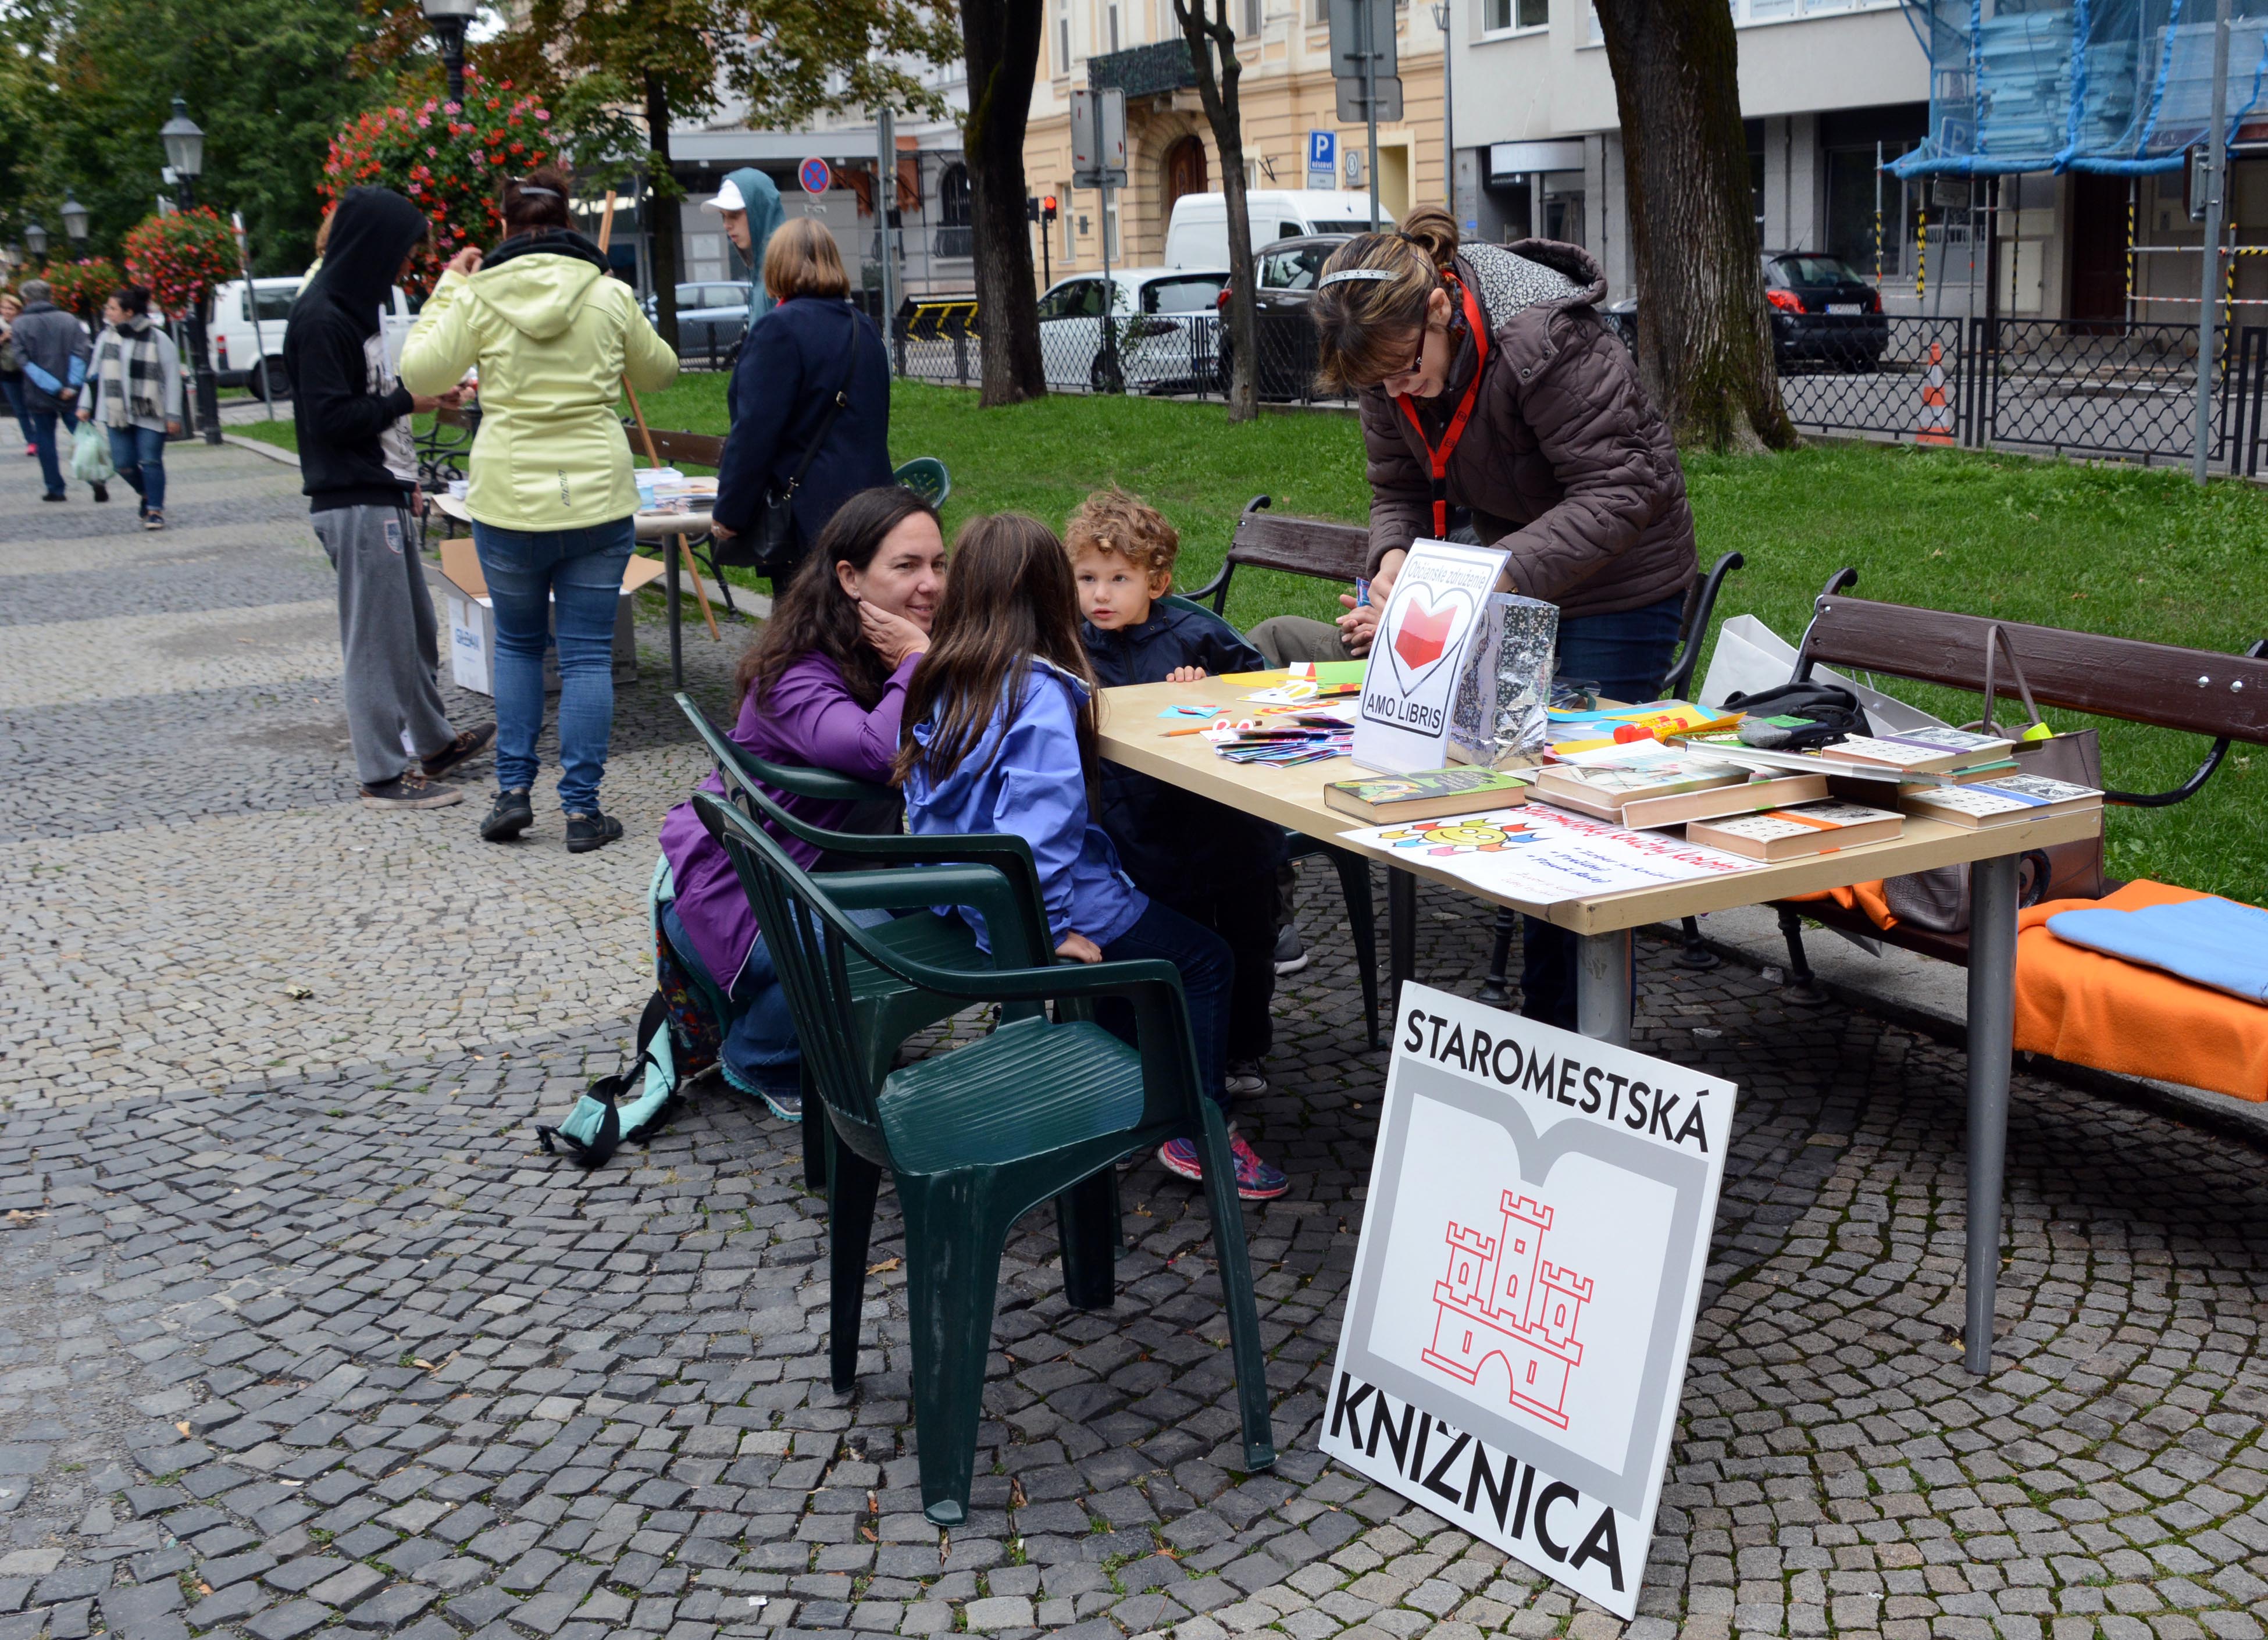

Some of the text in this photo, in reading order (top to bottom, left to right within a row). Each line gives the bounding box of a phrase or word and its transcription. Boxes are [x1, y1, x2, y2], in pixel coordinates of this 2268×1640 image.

[1316, 134, 1329, 158] P
[1366, 693, 1442, 728] AMO LIBRIS
[1403, 1008, 1710, 1153] STAROMESTSKÁ
[1329, 1371, 1625, 1593] KNIŽNICA
